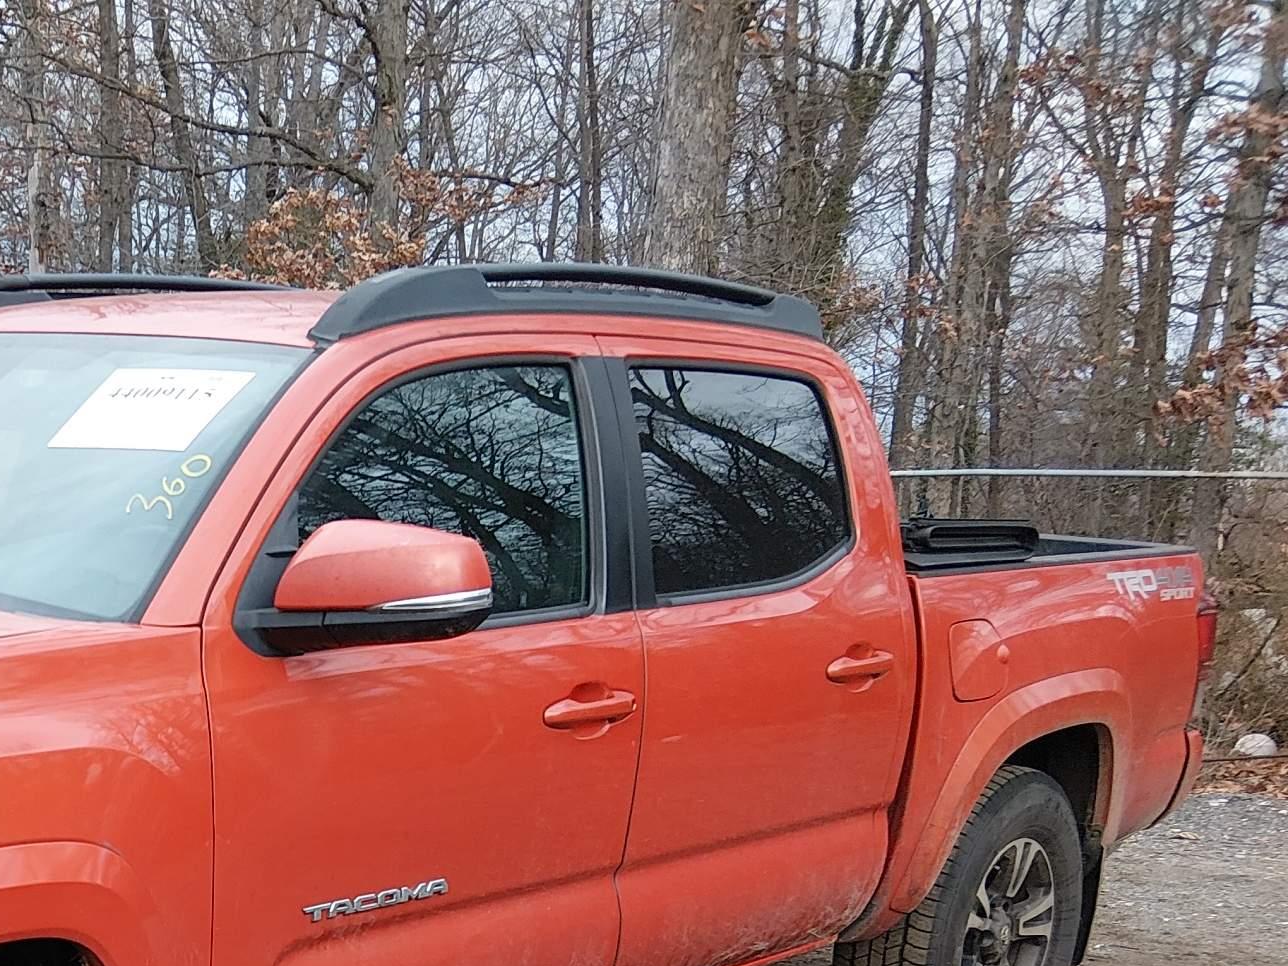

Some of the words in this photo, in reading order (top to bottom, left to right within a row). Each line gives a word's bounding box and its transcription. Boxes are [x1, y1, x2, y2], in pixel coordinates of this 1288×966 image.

[125, 454, 212, 520] 360
[1106, 569, 1157, 601] TRD
[303, 878, 449, 922] TACOMA
